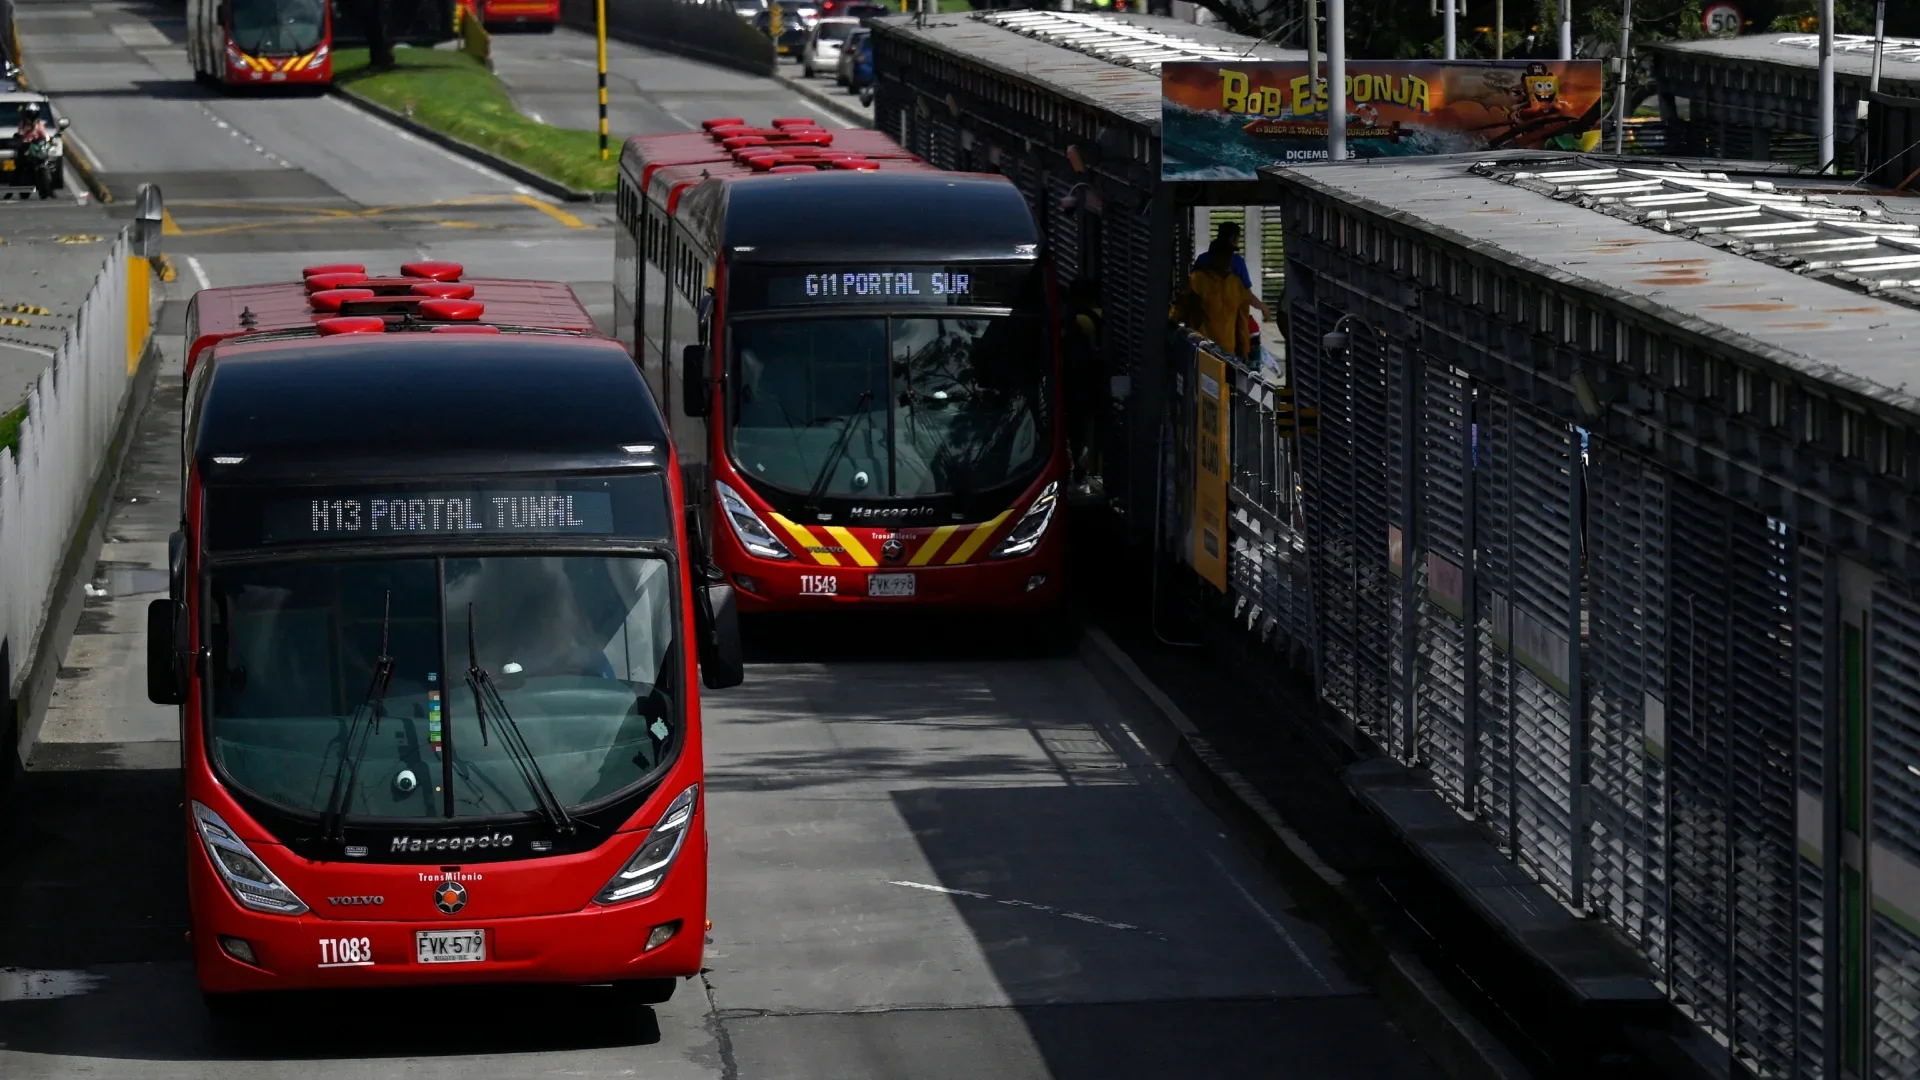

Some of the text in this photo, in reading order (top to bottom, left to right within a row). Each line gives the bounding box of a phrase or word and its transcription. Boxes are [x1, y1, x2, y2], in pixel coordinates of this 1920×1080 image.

[1712, 14, 1737, 32] 50
[1264, 126, 1287, 134] BUSCA
[1286, 150, 1329, 160] DICIEMB
[806, 272, 969, 296] G11 PORTAL SUR
[312, 495, 584, 531] H13 PORTAL TUNAL
[850, 505, 935, 518] Marcopolo
[871, 532, 917, 540] TransMilenio
[800, 575, 837, 594] T1543
[390, 832, 513, 853] Marcopolo
[418, 871, 483, 882] TransMilenio
[327, 895, 385, 906] VOLVO
[319, 936, 372, 964] T1083
